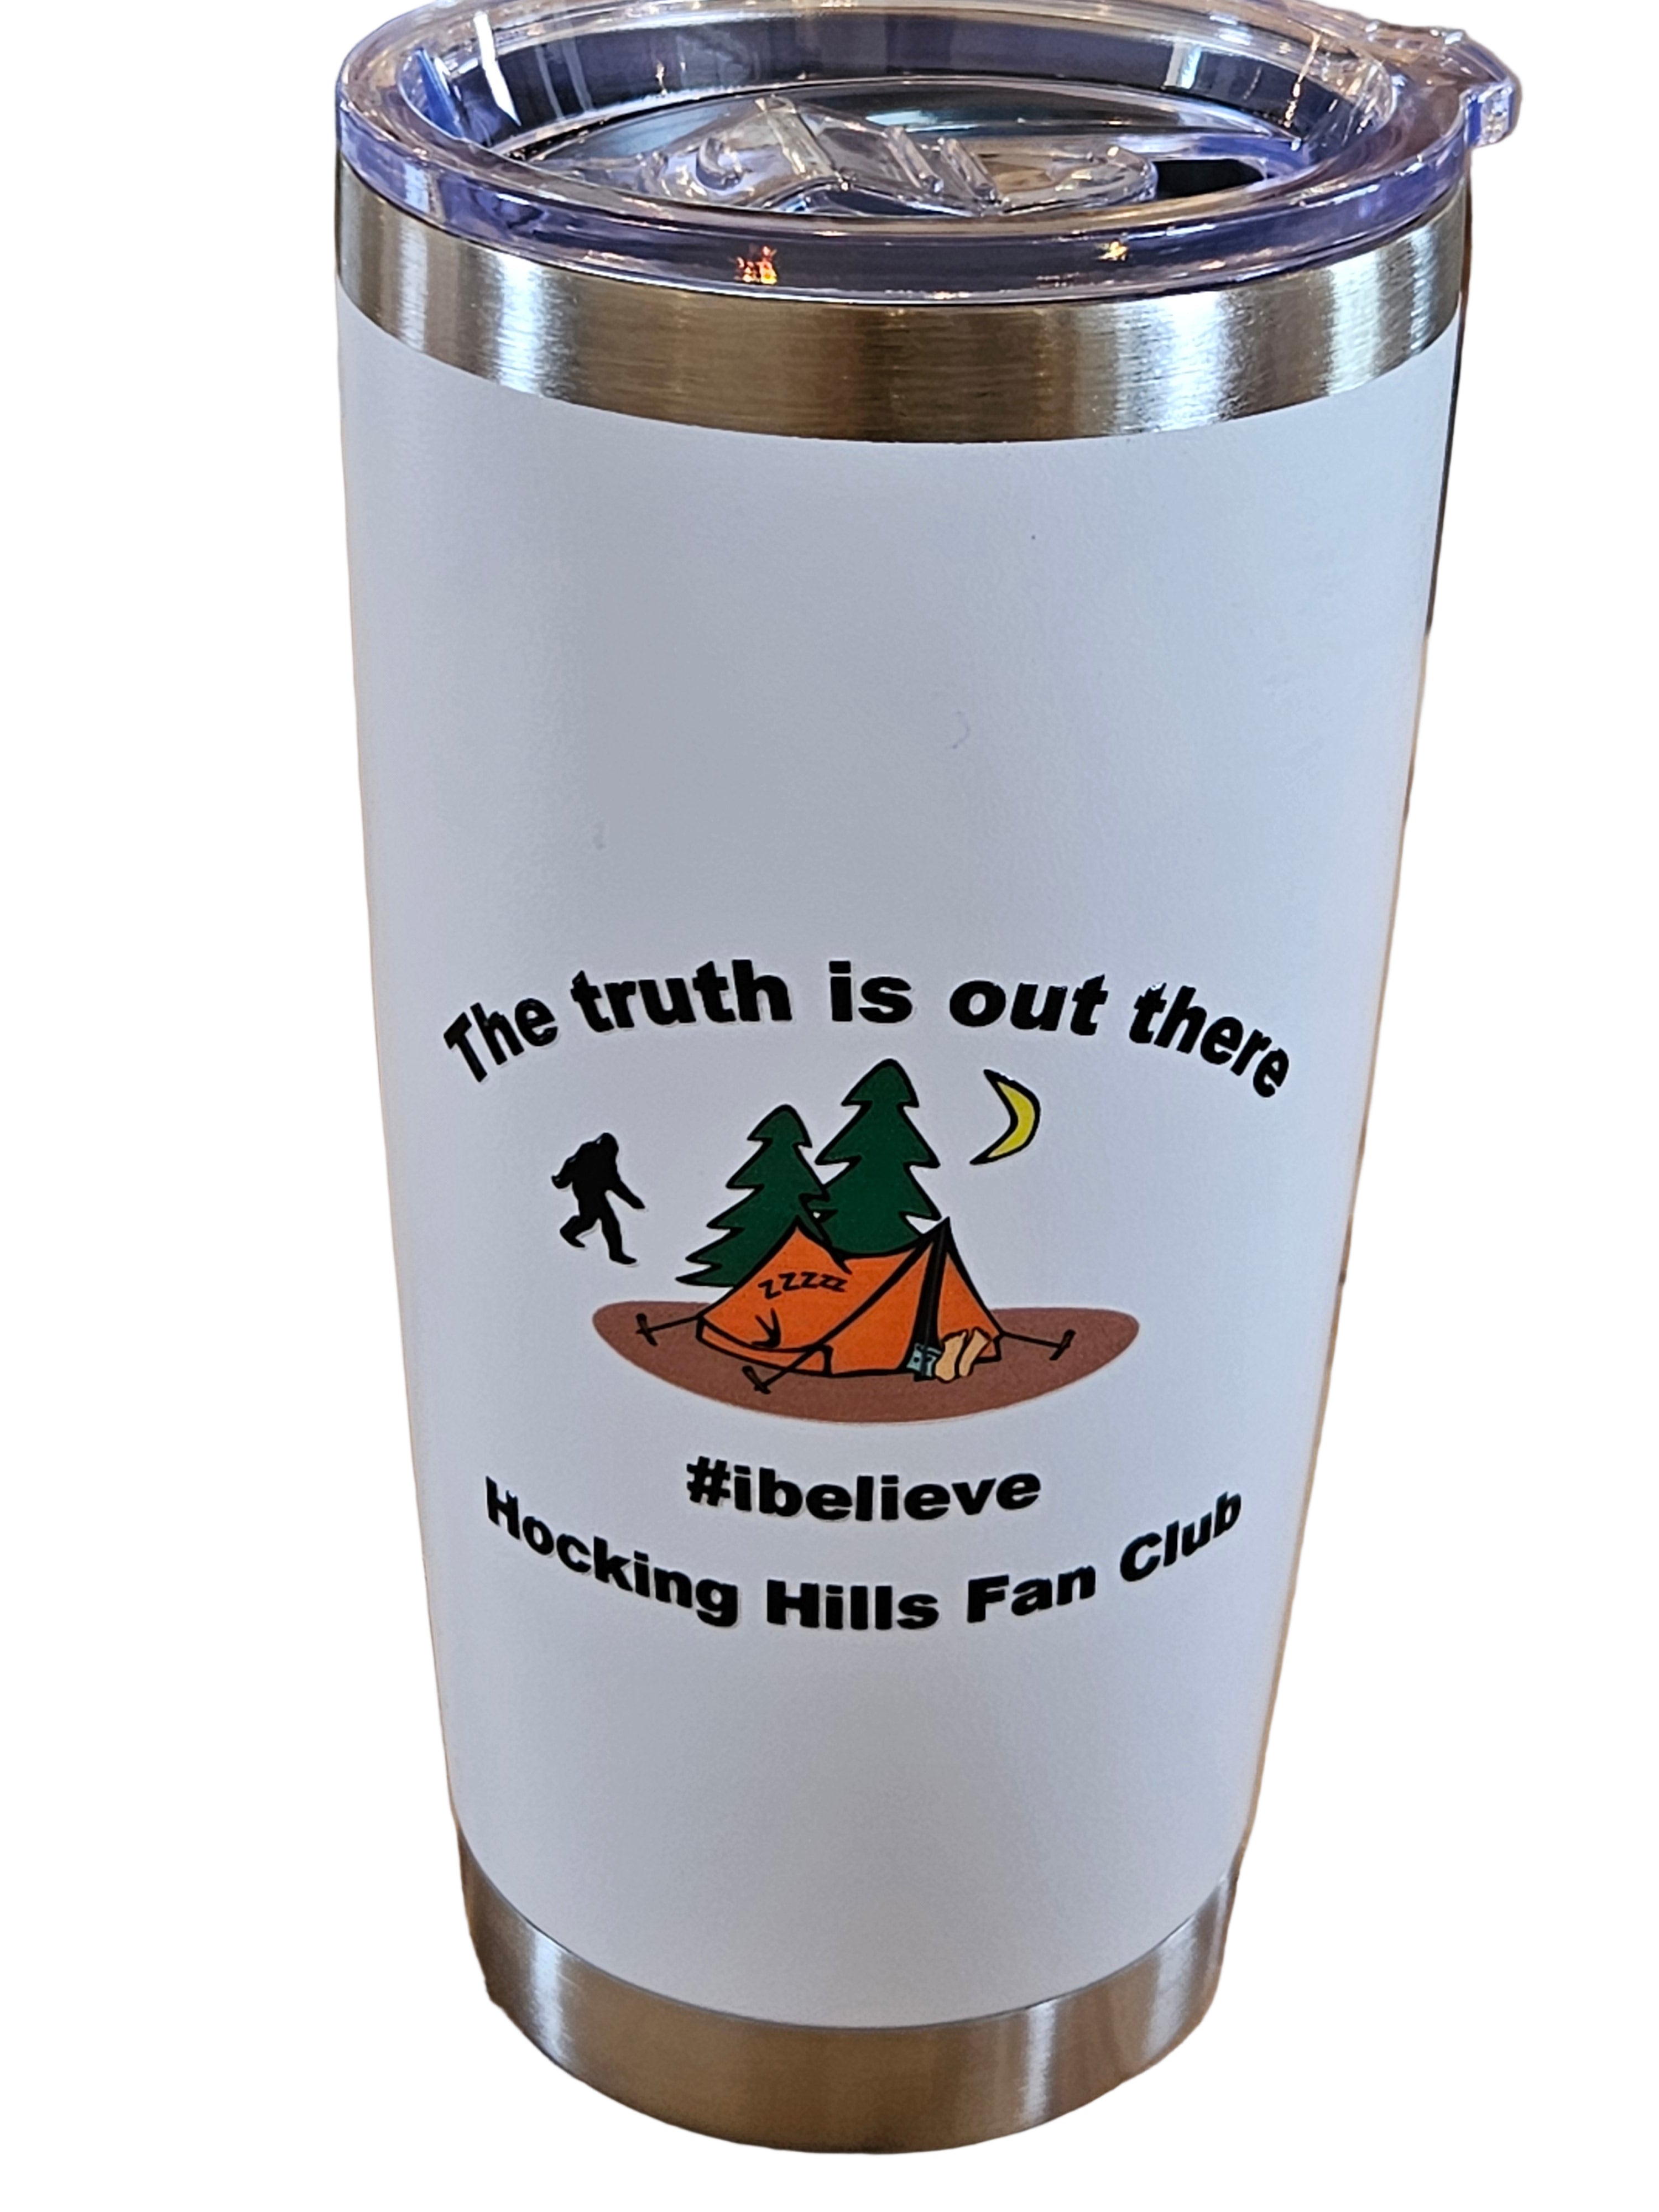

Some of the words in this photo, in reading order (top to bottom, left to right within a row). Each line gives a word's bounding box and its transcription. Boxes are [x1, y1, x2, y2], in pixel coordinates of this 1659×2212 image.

[443, 998, 558, 1083] The
[570, 959, 793, 1033] truth
[828, 960, 913, 1024] is
[949, 974, 1109, 1036] out
[1128, 982, 1290, 1098] there
[486, 1476, 739, 1628] Hocking
[766, 1579, 940, 1631] Hills
[967, 1565, 1096, 1624] Fan
[1119, 1493, 1242, 1583] Club
[686, 1455, 1041, 1522] #ibelieve
